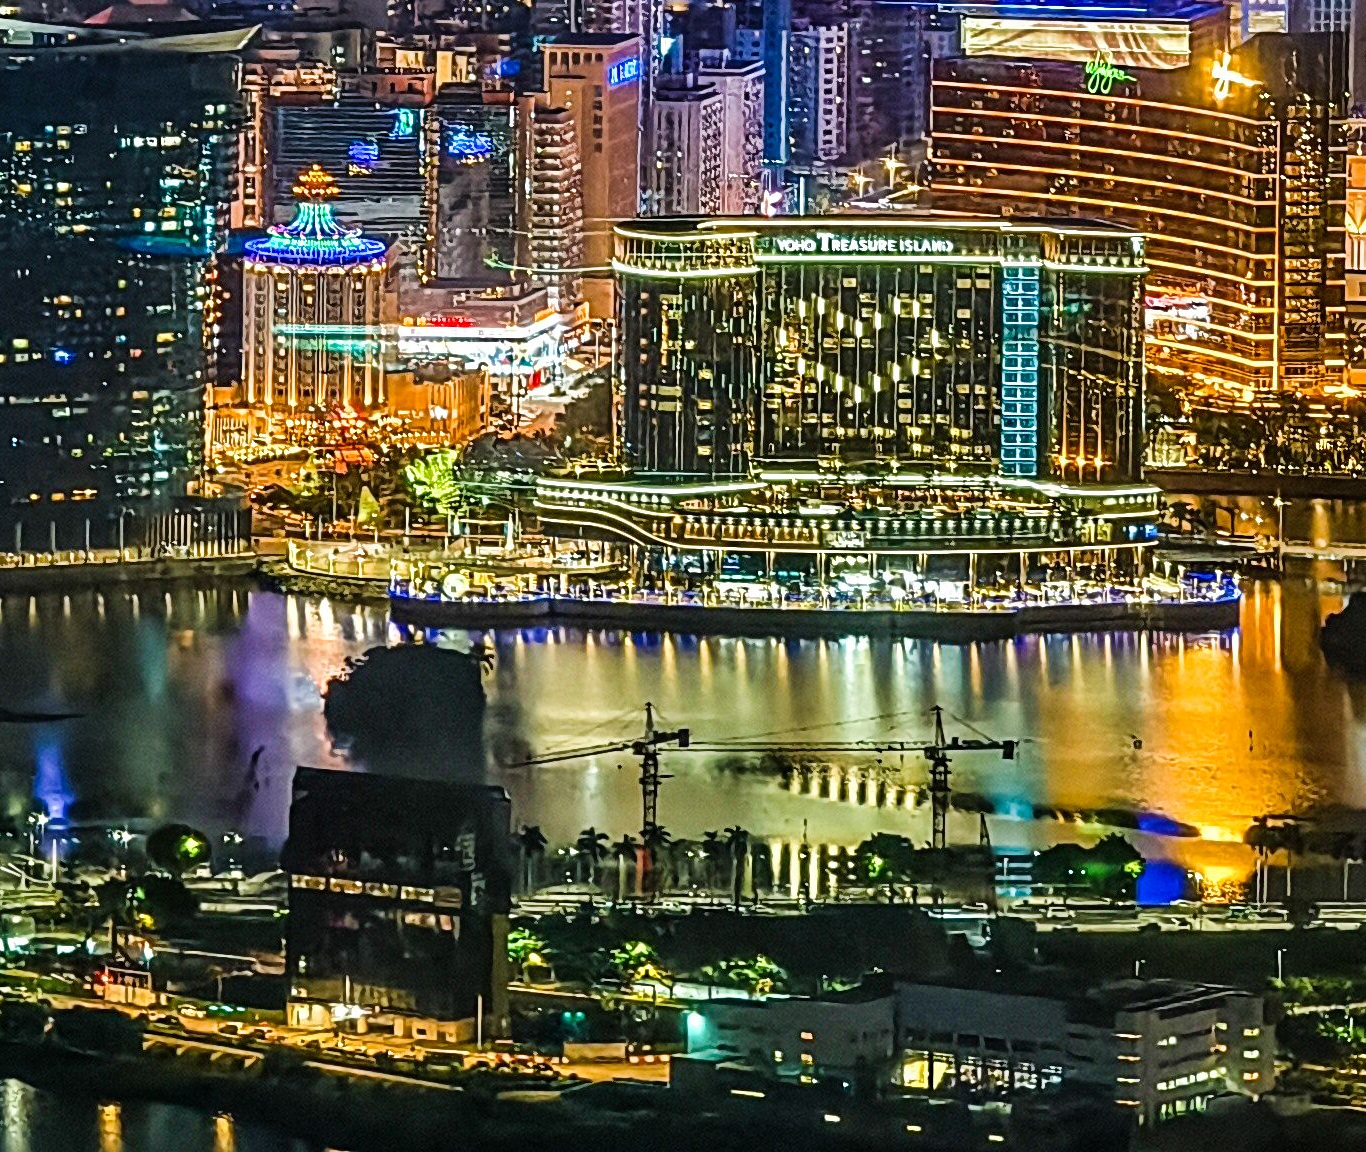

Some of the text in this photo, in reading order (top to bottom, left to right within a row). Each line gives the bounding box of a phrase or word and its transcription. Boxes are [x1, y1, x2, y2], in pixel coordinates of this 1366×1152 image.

[777, 232, 954, 252] YOHO TREASURE ISLAND
